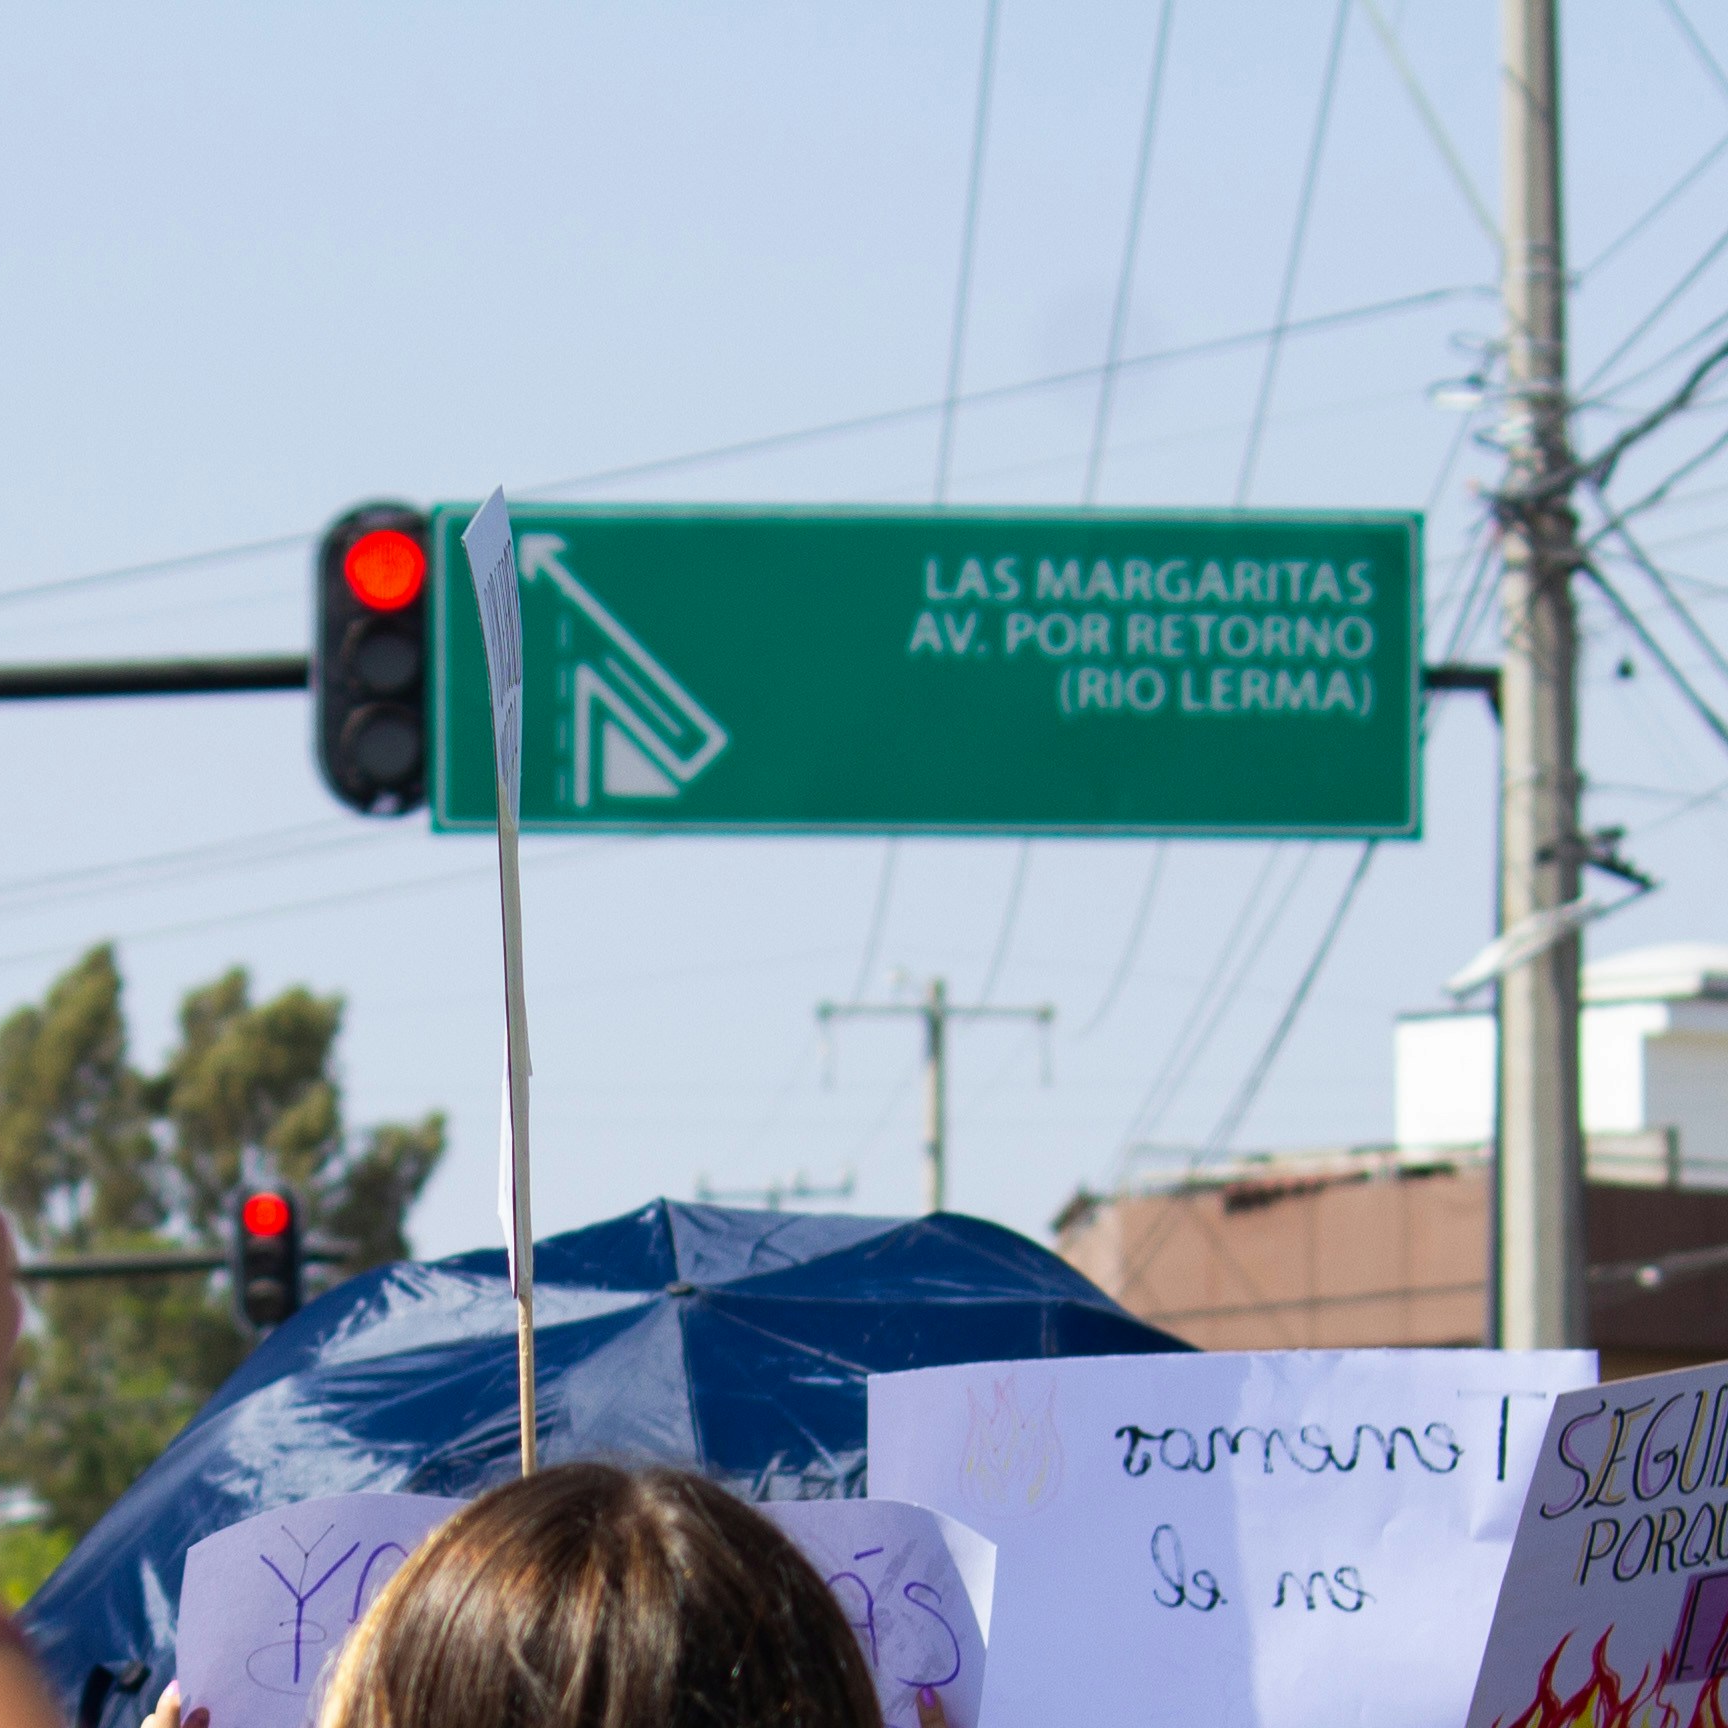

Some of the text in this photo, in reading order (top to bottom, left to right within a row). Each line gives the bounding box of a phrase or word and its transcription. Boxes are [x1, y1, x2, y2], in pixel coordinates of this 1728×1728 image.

[924, 558, 1373, 605] LAS MARGARITAS
[906, 612, 1374, 660] AV. POR RETORNO
[1058, 667, 1372, 717] (RIO LERMA)
